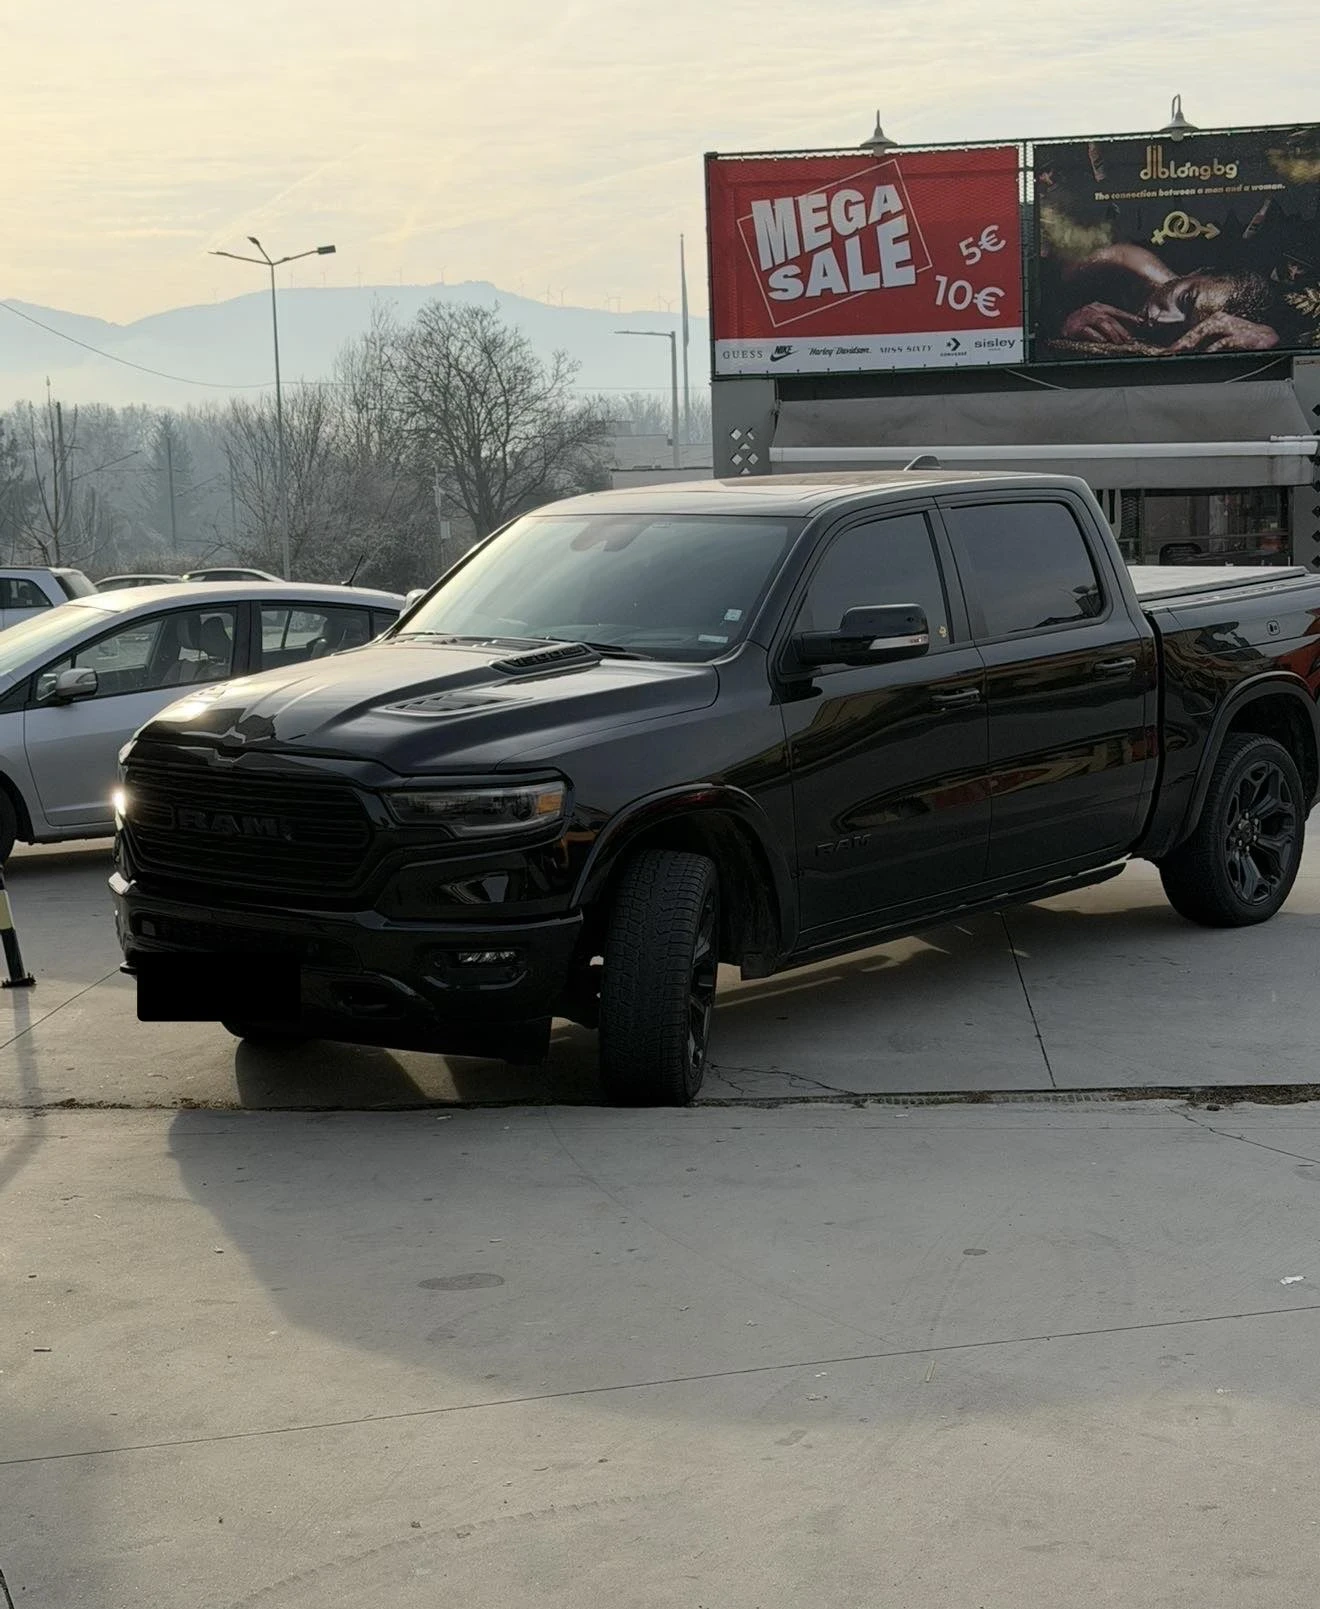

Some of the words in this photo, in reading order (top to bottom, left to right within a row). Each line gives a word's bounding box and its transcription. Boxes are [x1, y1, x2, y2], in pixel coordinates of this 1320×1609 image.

[1094, 191, 1110, 200] The
[1111, 189, 1157, 199] connection
[1158, 188, 1196, 197] between
[1225, 184, 1242, 192] and
[751, 184, 904, 271] MEGA
[768, 214, 916, 301] SALE
[959, 225, 1007, 265] 5€
[935, 275, 1005, 317] 10€
[723, 350, 763, 359] GUESS
[775, 345, 793, 355] NIKE
[974, 338, 1016, 349] sisley
[176, 807, 280, 837] RAM
[815, 831, 872, 854] RAM
